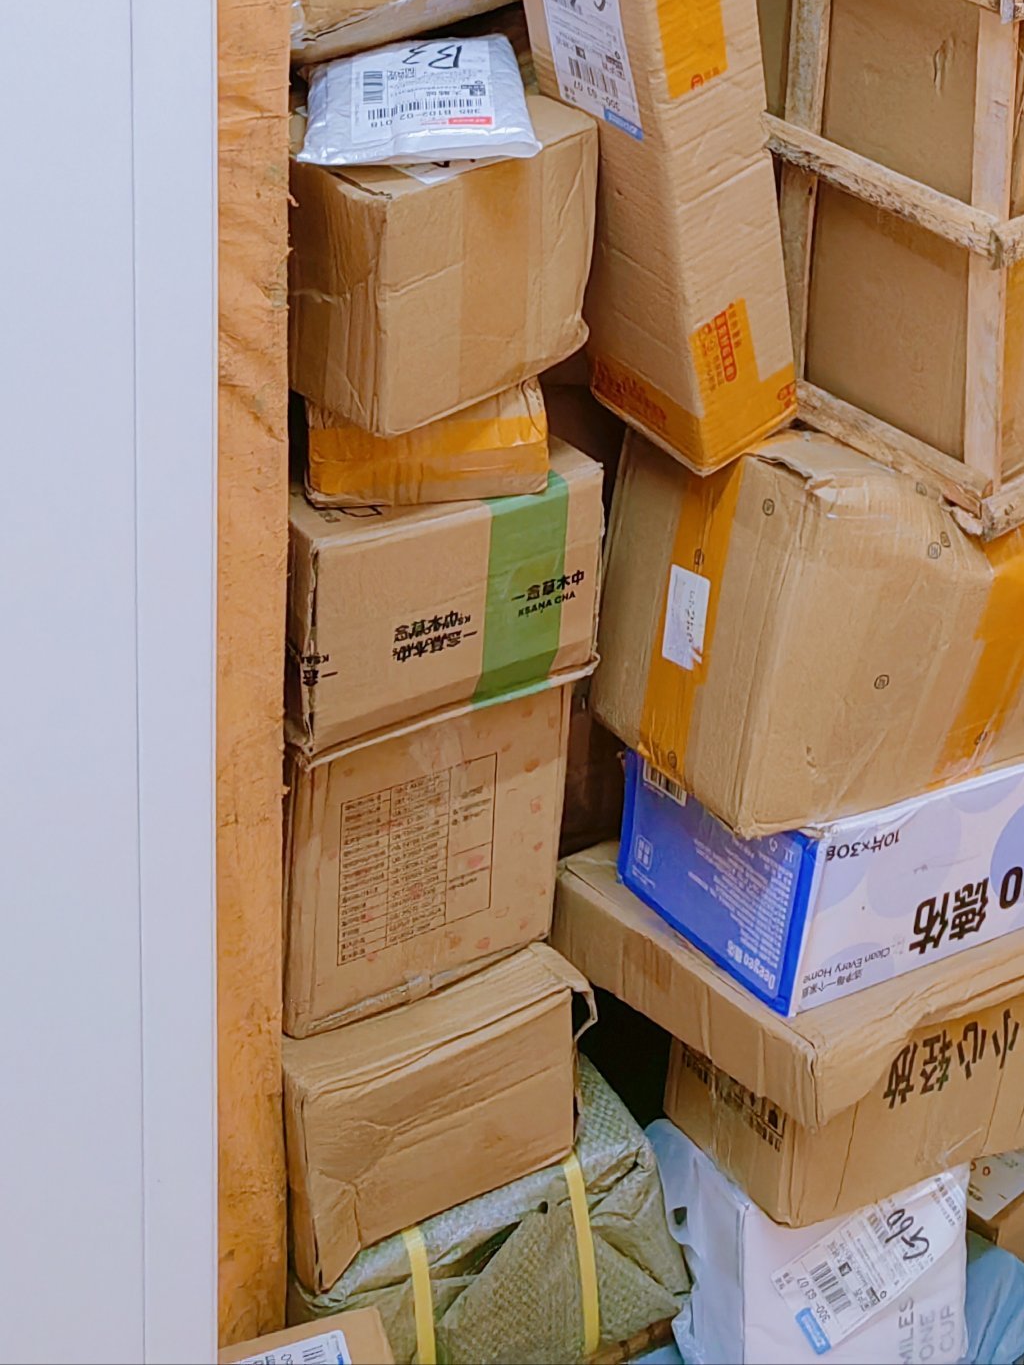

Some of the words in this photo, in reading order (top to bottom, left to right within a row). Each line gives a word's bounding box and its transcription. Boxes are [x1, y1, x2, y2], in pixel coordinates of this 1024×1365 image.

[402, 42, 463, 69] B3
[909, 876, 989, 955] 德佑
[835, 956, 864, 974] Every
[864, 945, 891, 963] Clean
[802, 966, 832, 985] Home
[883, 1008, 1020, 1109] 小心轻放
[885, 1208, 930, 1262] G60
